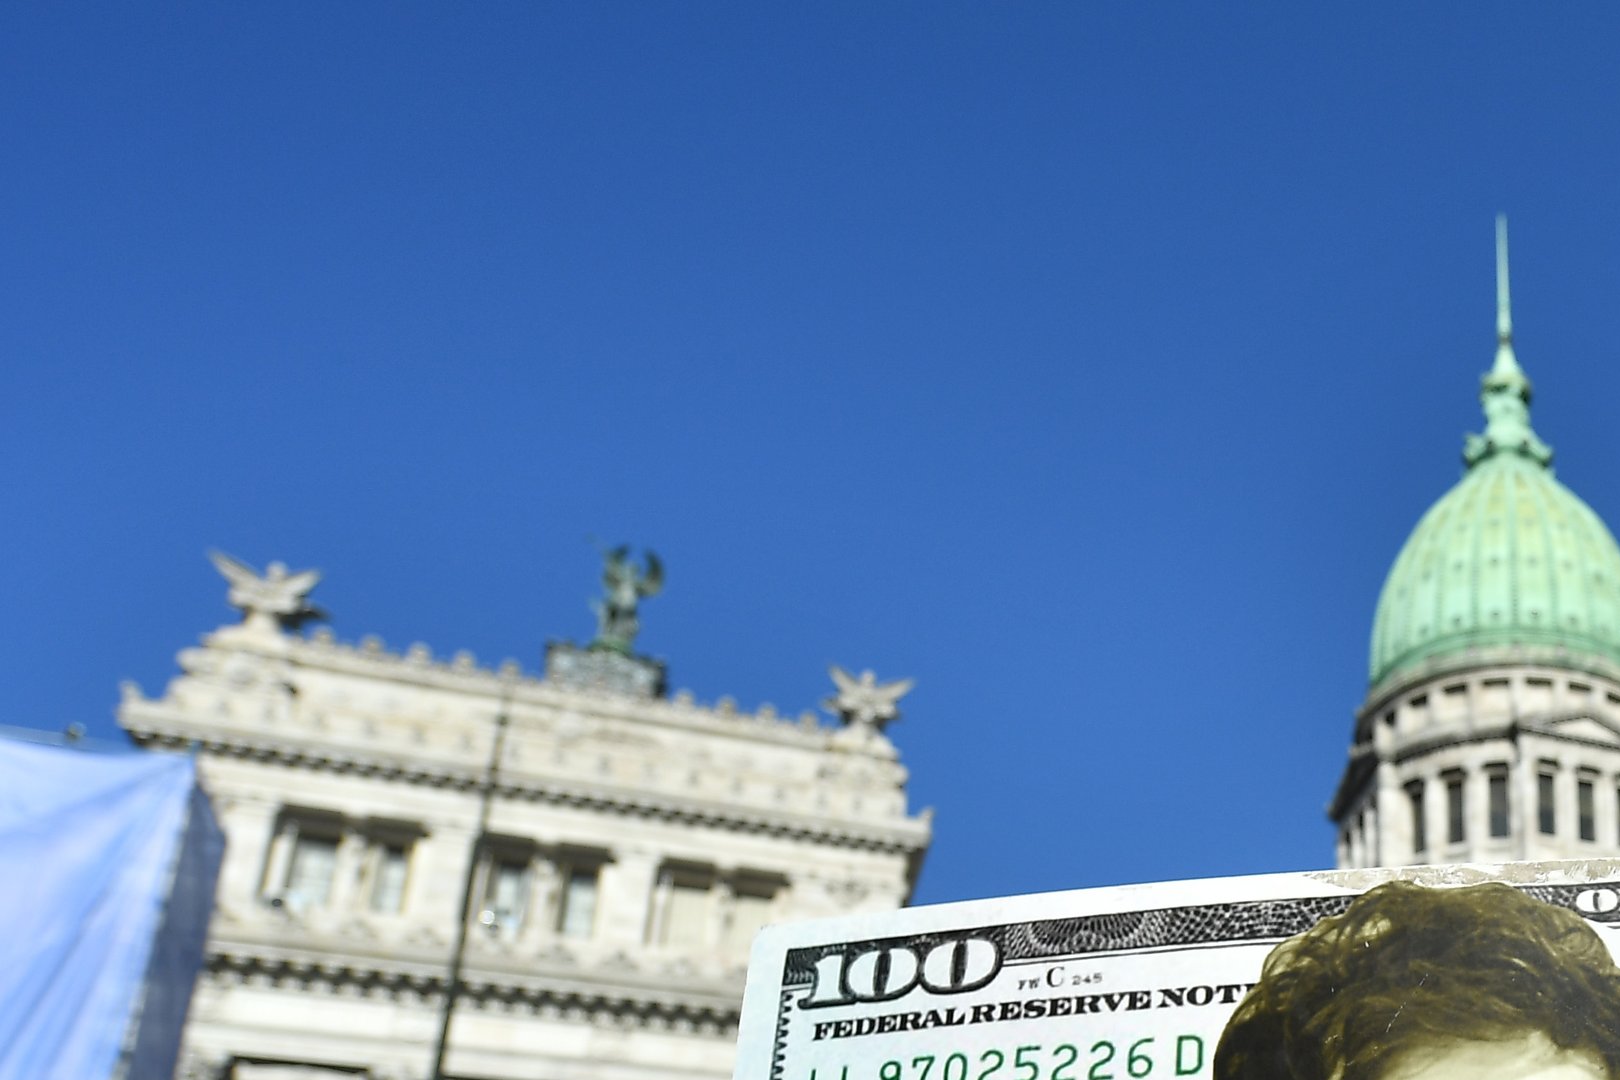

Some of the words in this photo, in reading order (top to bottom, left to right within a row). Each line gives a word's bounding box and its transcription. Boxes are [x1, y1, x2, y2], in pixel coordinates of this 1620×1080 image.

[799, 938, 1002, 1010] 100
[812, 1008, 967, 1040] FEDERAL
[970, 990, 1151, 1023] RESERVE
[1158, 980, 1255, 1008] NOT
